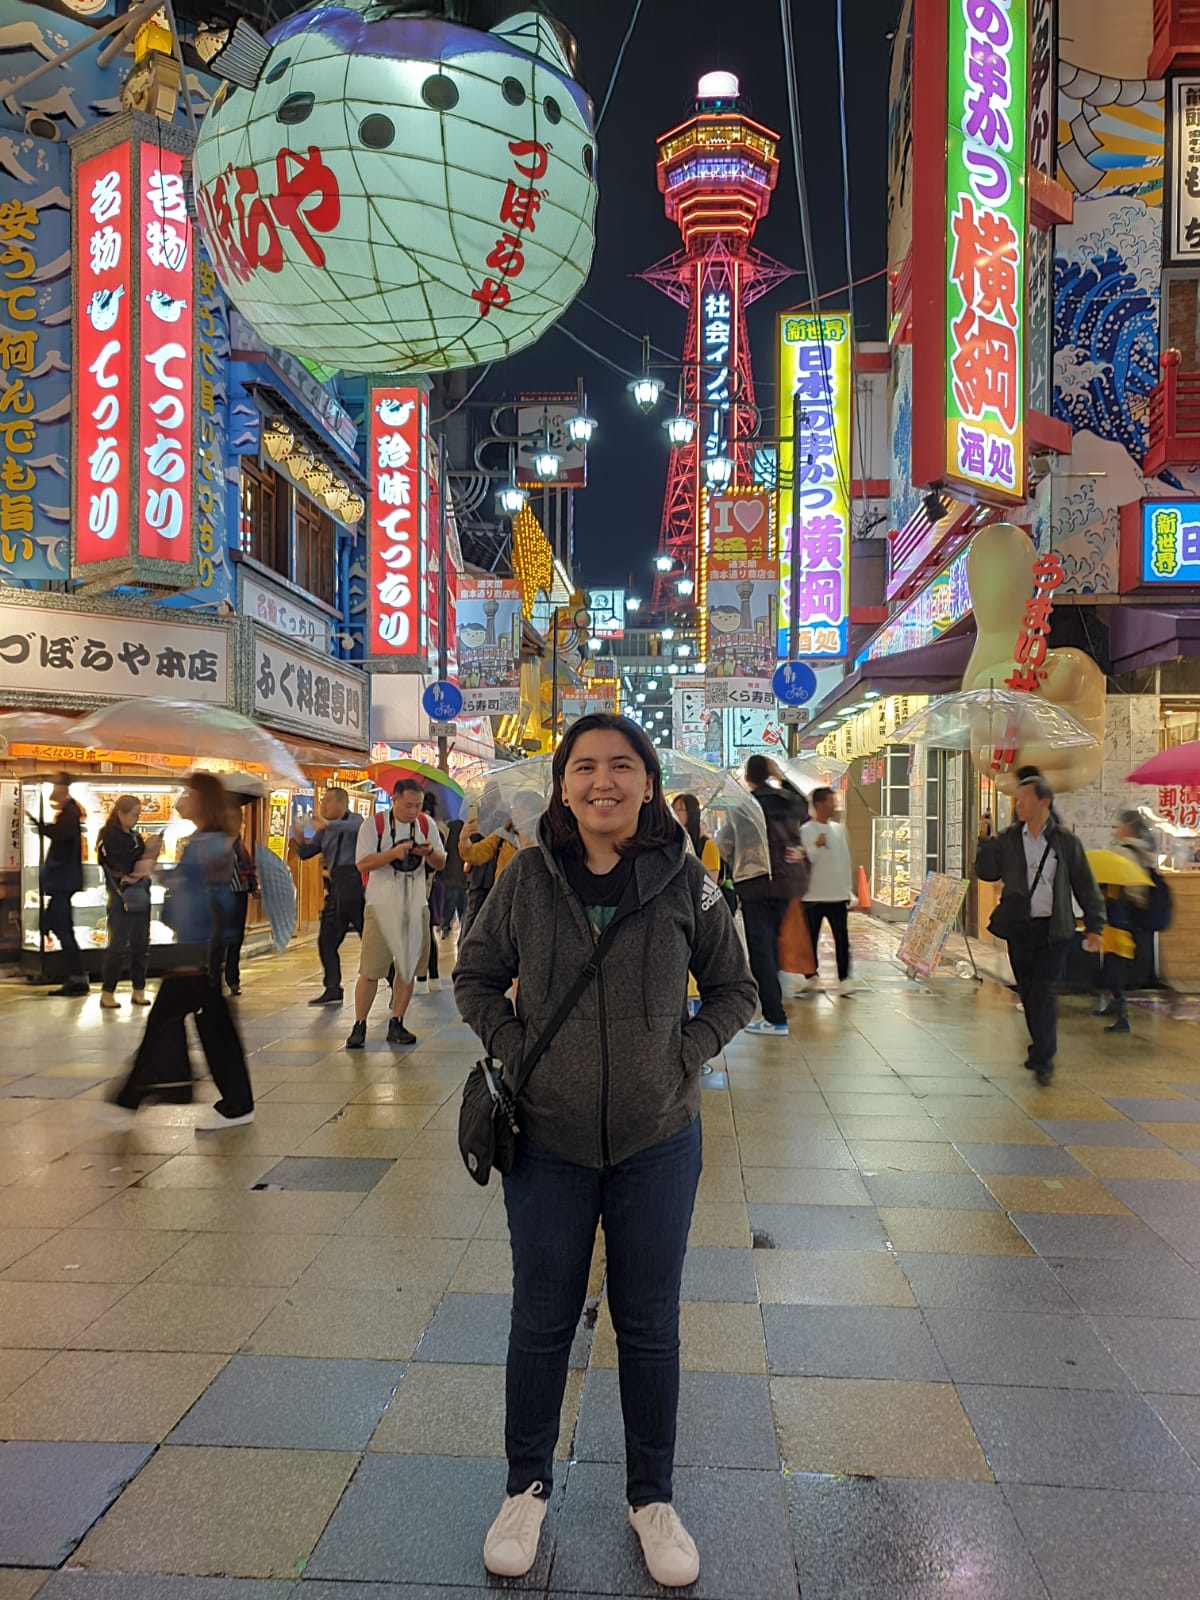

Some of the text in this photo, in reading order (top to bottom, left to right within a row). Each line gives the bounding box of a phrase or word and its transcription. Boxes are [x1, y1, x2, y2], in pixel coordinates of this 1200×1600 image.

[471, 139, 553, 317] づぼらや
[89, 171, 121, 540] 名物 てっちり
[786, 319, 845, 341] 新世界
[145, 343, 187, 538] てっちり
[960, 427, 1014, 484] 酒処
[376, 433, 412, 646] 珍味てっちり
[1156, 513, 1177, 573] 新世界
[0, 633, 219, 683] づぼらや本店
[257, 652, 360, 730] ふぐ料理専門
[729, 690, 775, 705] くら寿司
